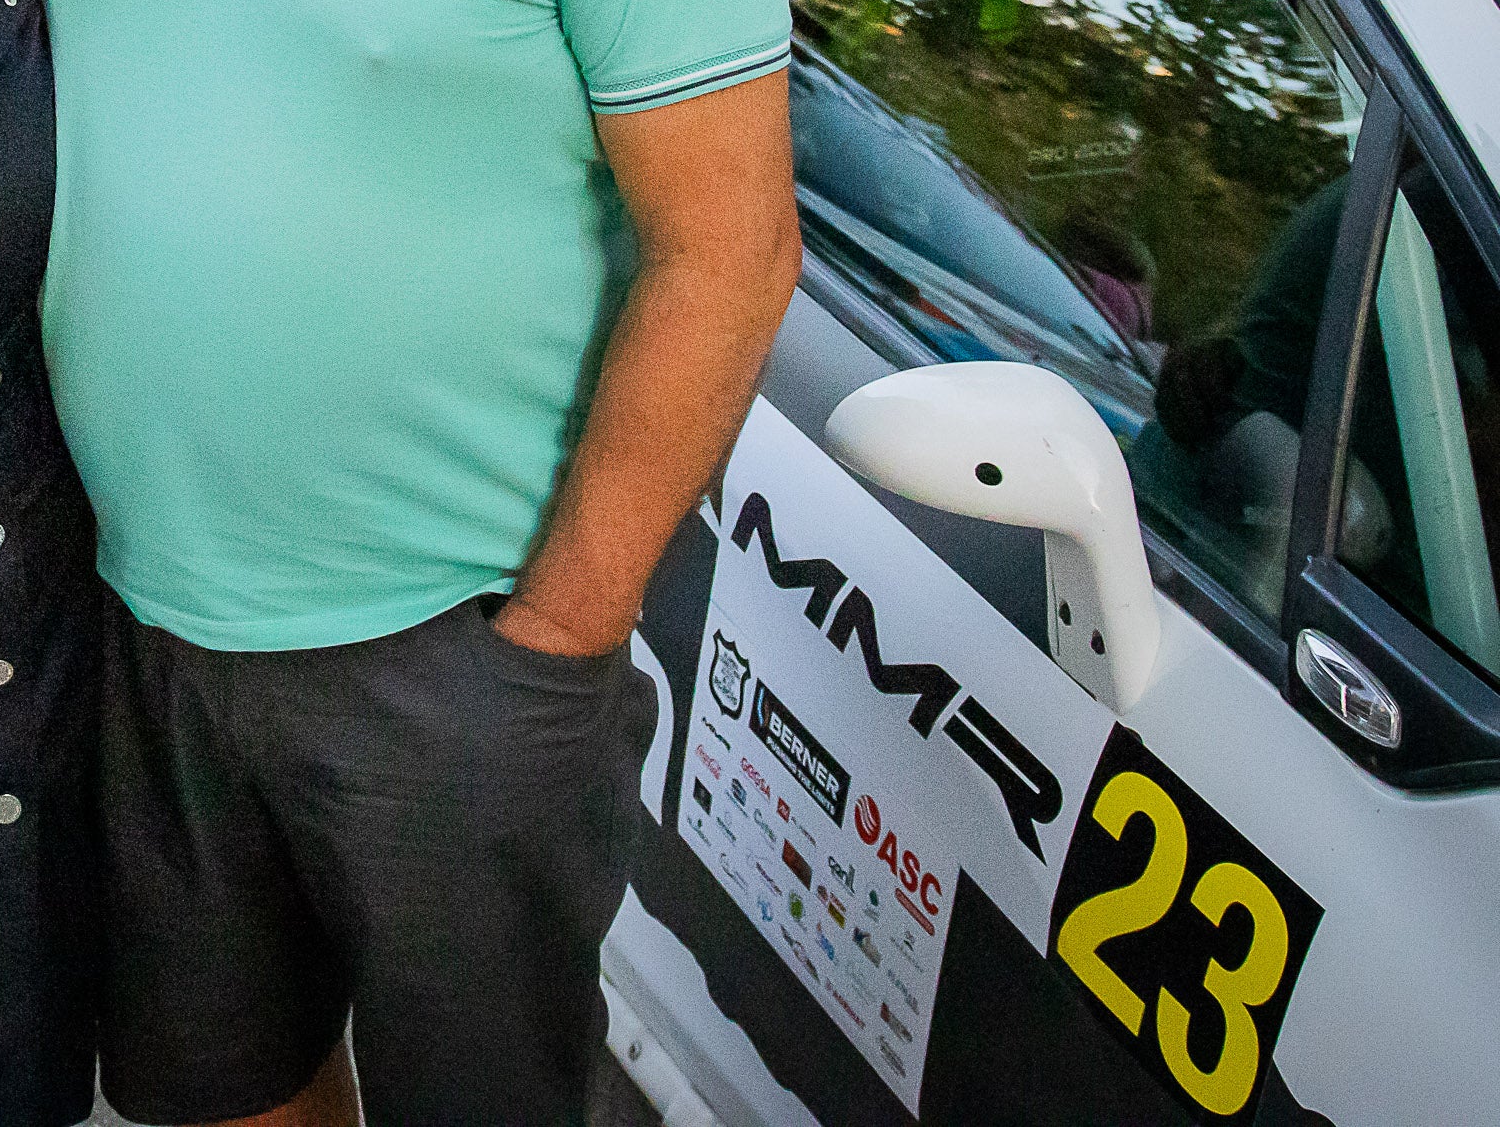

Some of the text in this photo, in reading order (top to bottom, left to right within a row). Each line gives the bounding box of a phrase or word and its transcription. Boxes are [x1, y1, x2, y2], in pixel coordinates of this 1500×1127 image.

[730, 491, 1065, 867] MMR
[768, 711, 841, 802] BERNER
[876, 829, 943, 917] ASC
[1056, 771, 1289, 1116] 23
